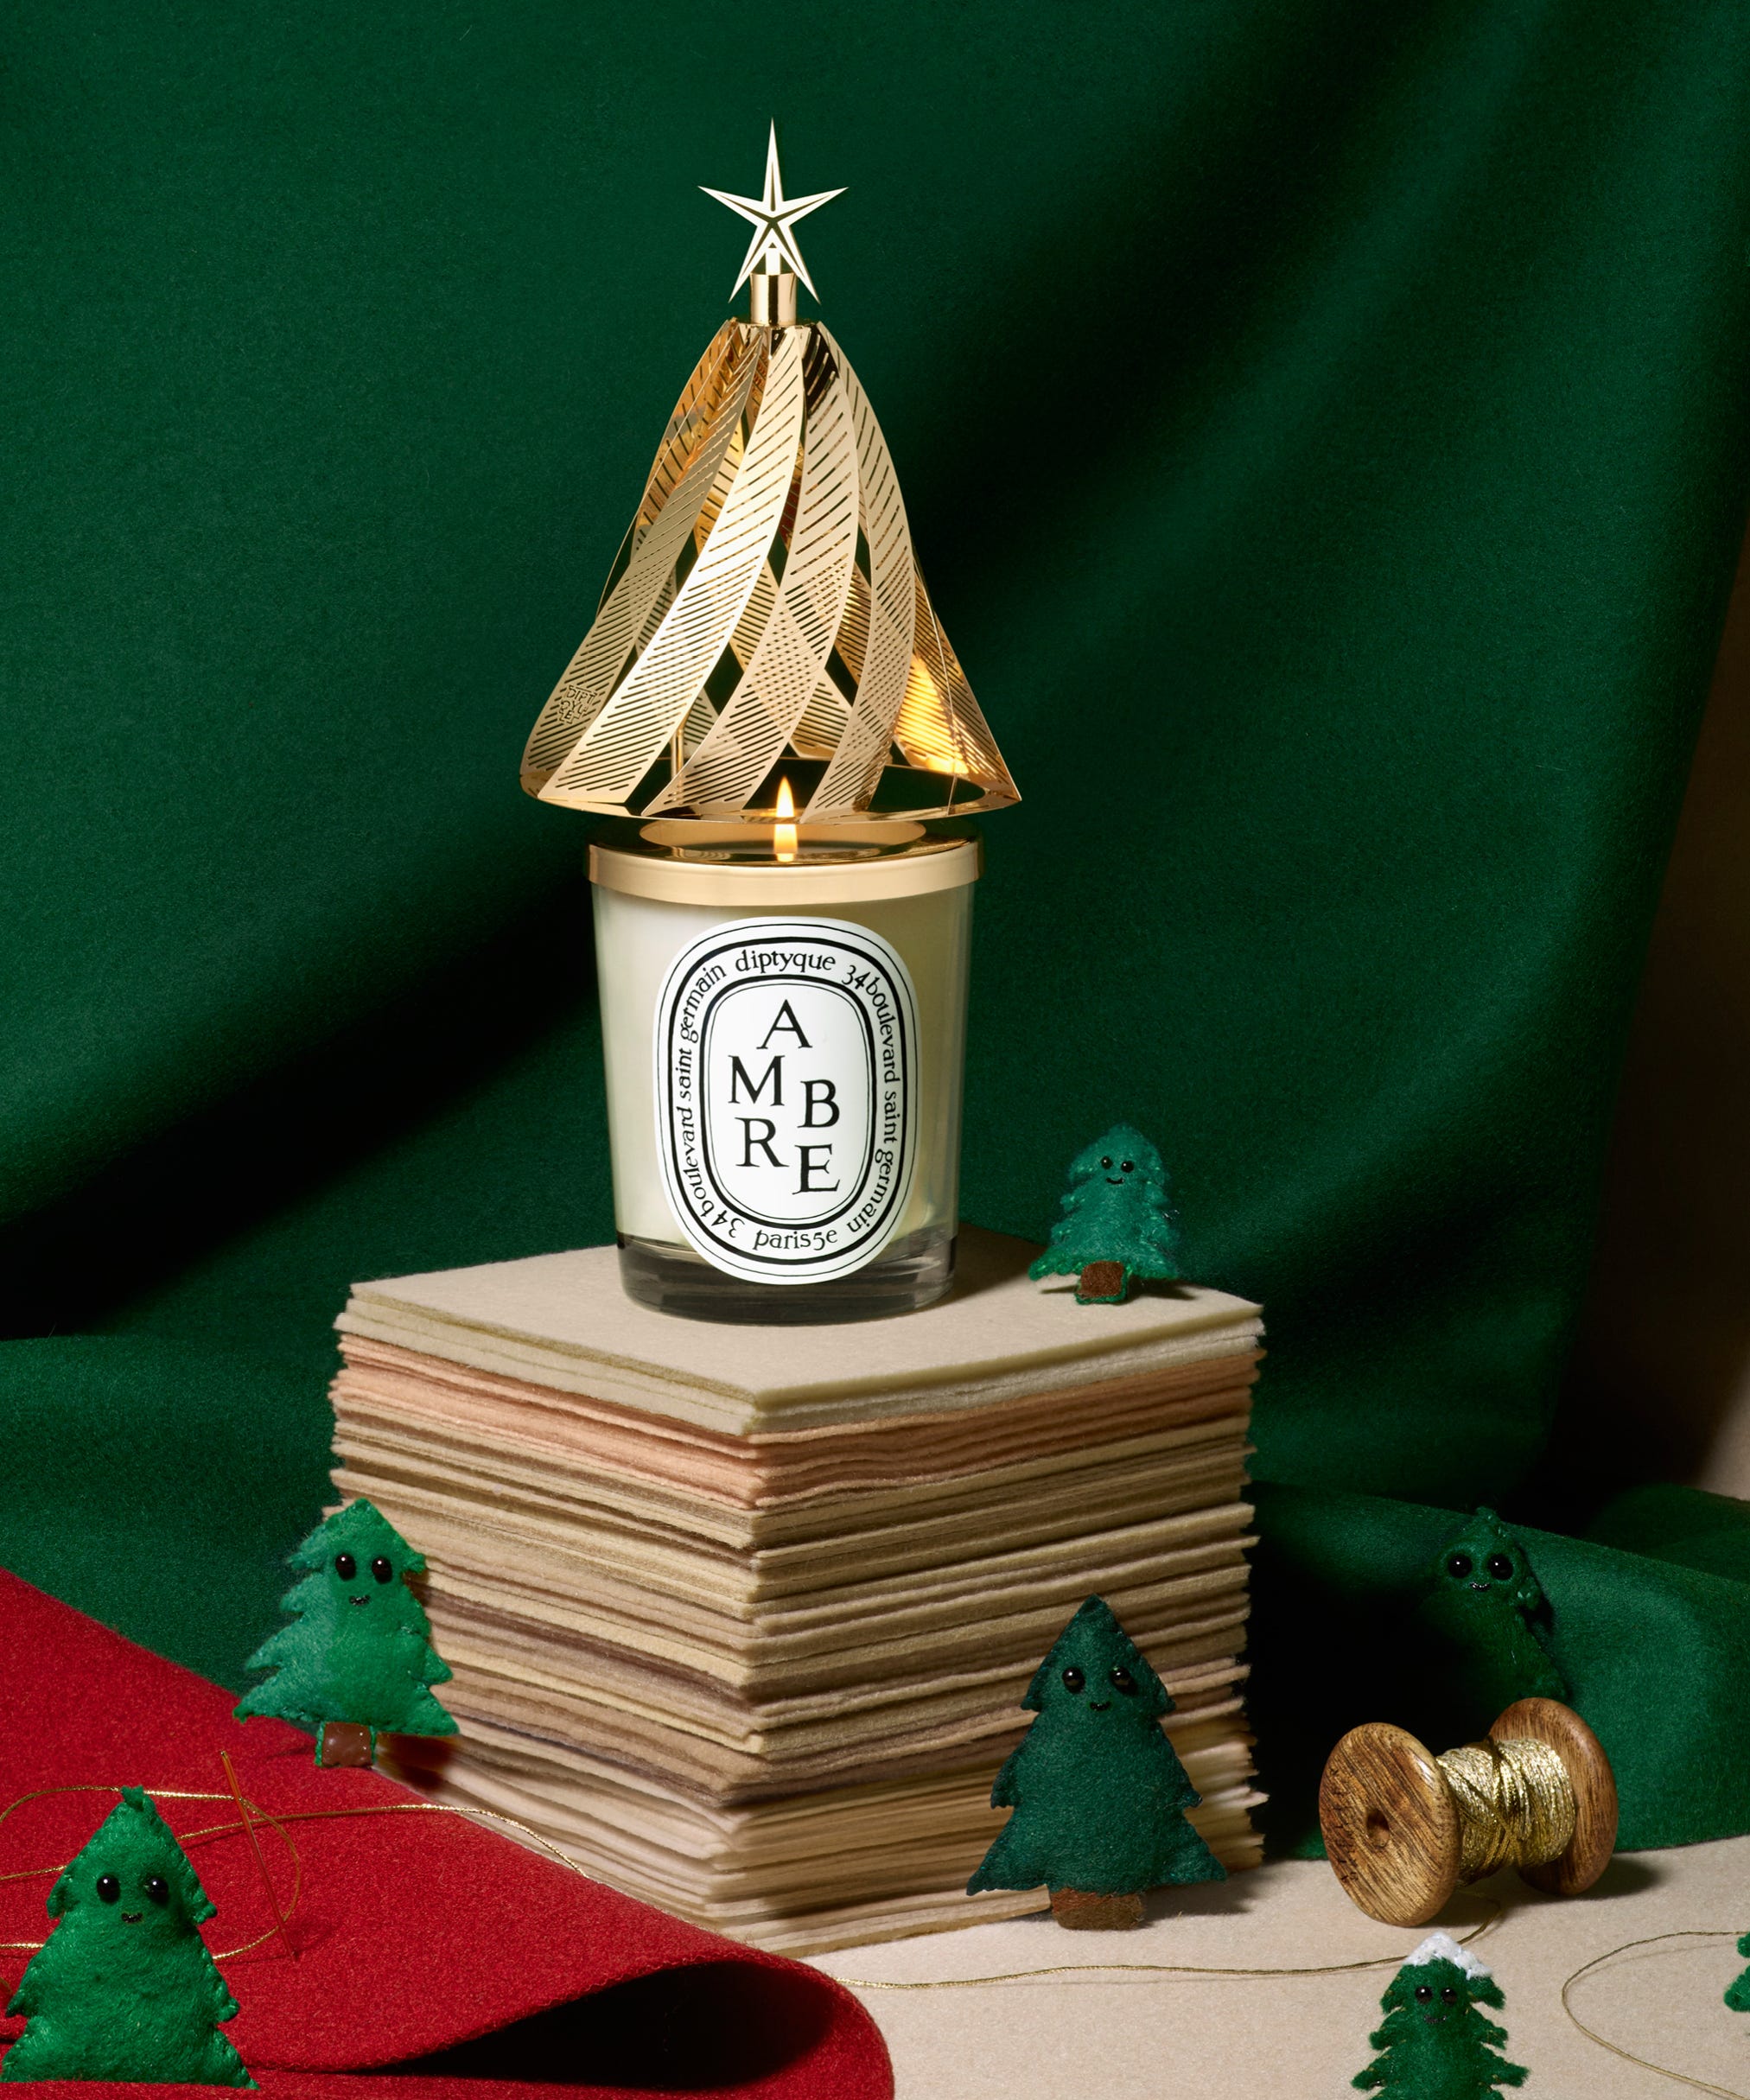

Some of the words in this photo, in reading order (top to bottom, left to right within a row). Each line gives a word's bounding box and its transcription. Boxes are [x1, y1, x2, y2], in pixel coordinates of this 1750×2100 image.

[735, 949, 837, 974] diptyque
[680, 964, 728, 1044] germain
[675, 1047, 693, 1101] saint
[883, 1091, 901, 1144] saint
[846, 1149, 894, 1233] germain
